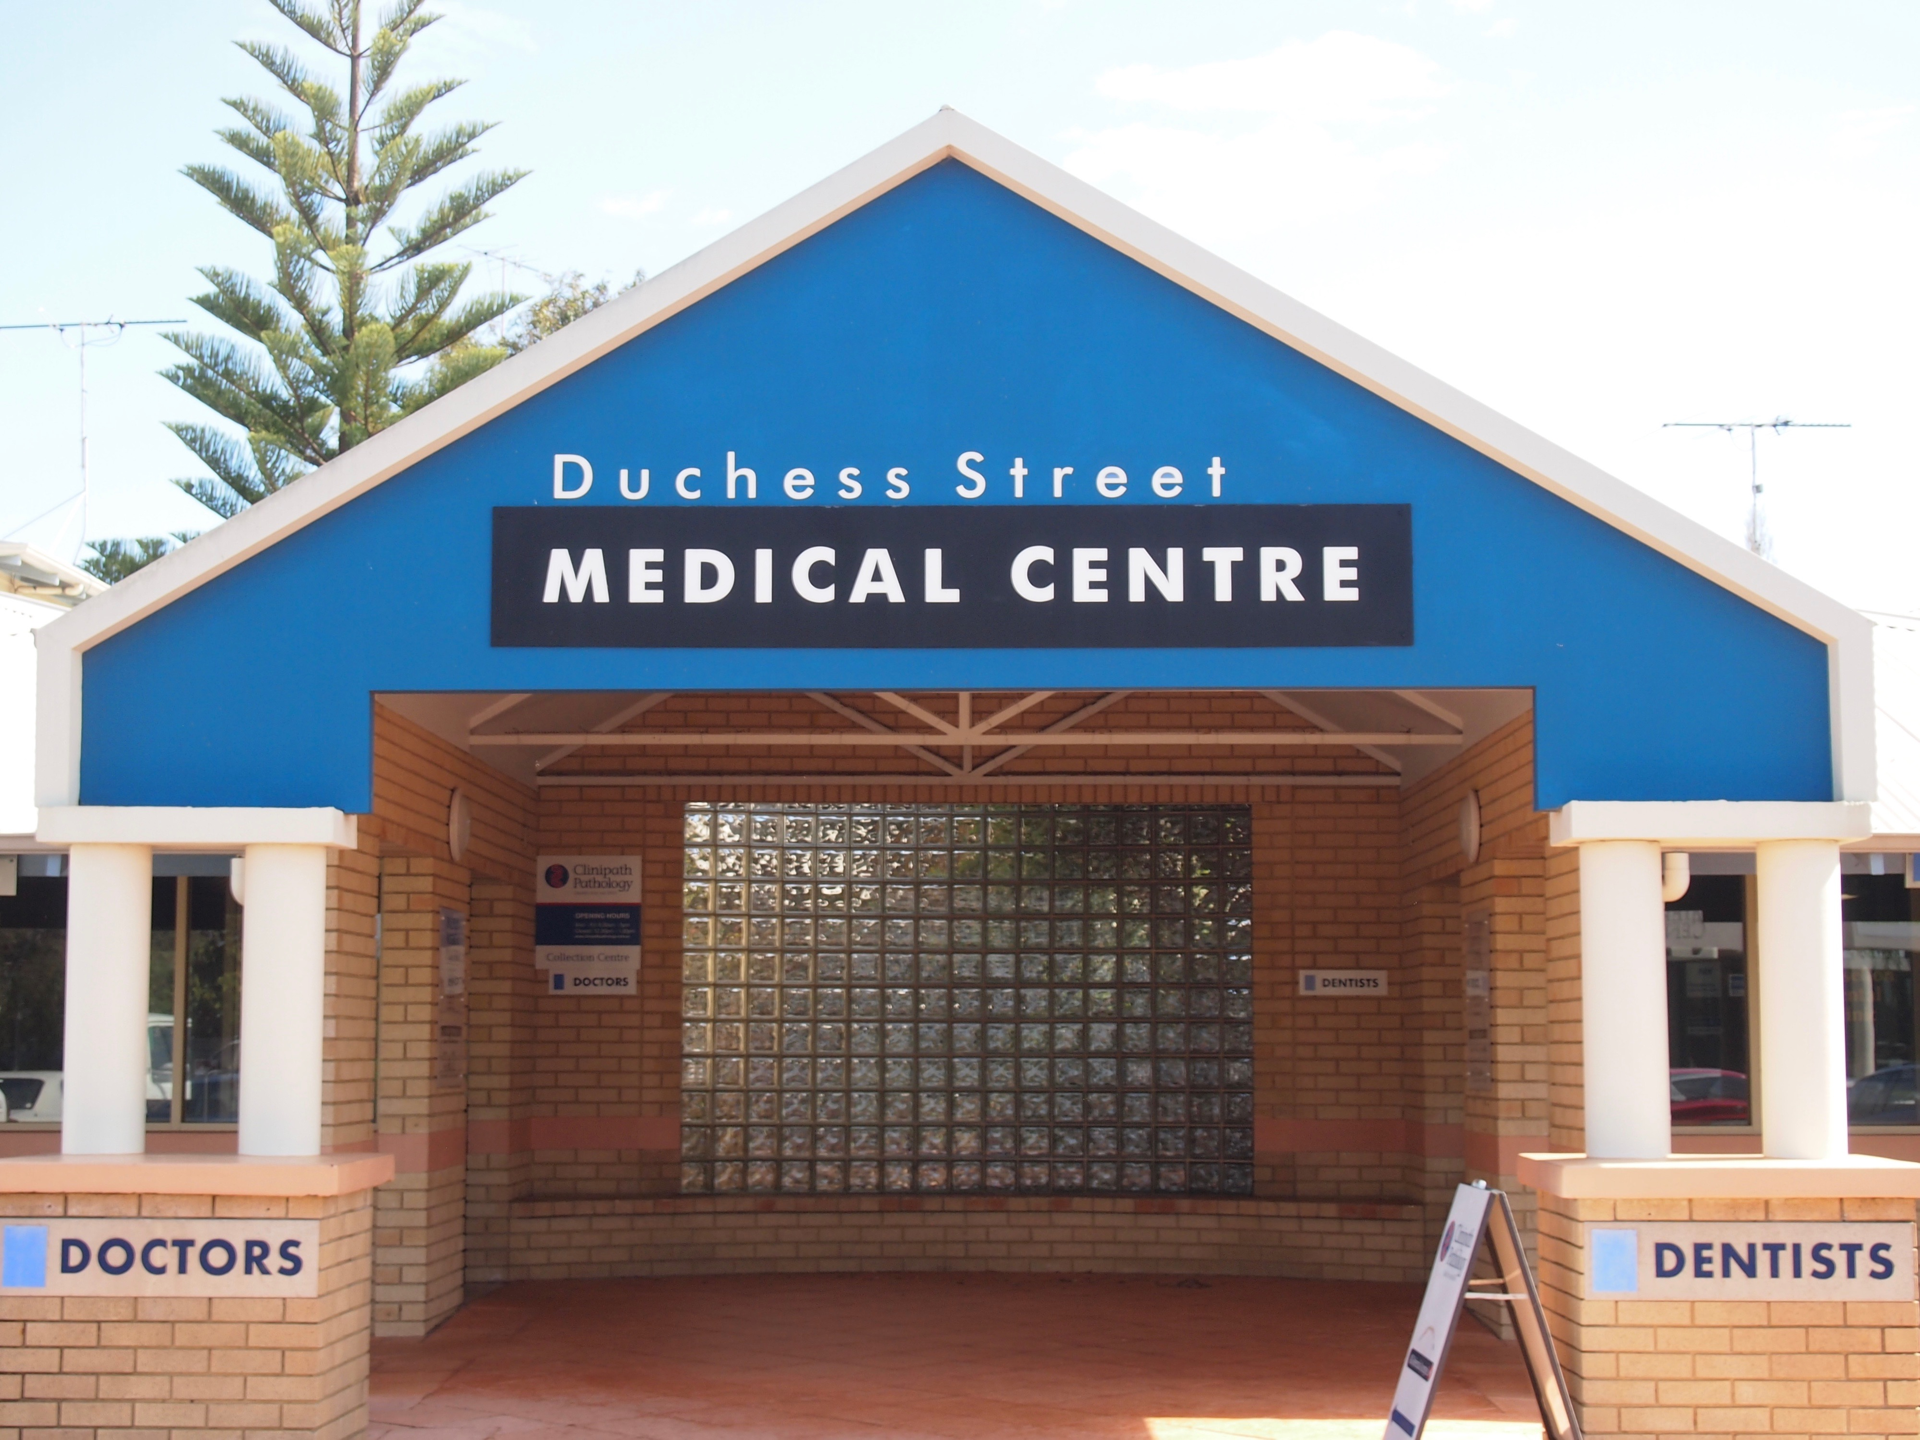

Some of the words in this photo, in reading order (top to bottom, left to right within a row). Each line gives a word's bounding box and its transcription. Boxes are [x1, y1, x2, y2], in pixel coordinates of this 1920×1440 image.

[553, 450, 911, 501] Duchess
[956, 450, 1228, 501] Street
[541, 545, 961, 605] MEDICAL
[1009, 544, 1362, 604] CENTRE
[573, 864, 633, 879] Clinipath
[573, 877, 633, 892] Pathology
[546, 952, 595, 962] Collection
[597, 952, 630, 962] Centre
[573, 977, 629, 987] DOCTORS
[1322, 978, 1380, 988] DENTISTS
[60, 1237, 304, 1277] DOCTORS
[1655, 1241, 1896, 1281] DENTISTS
